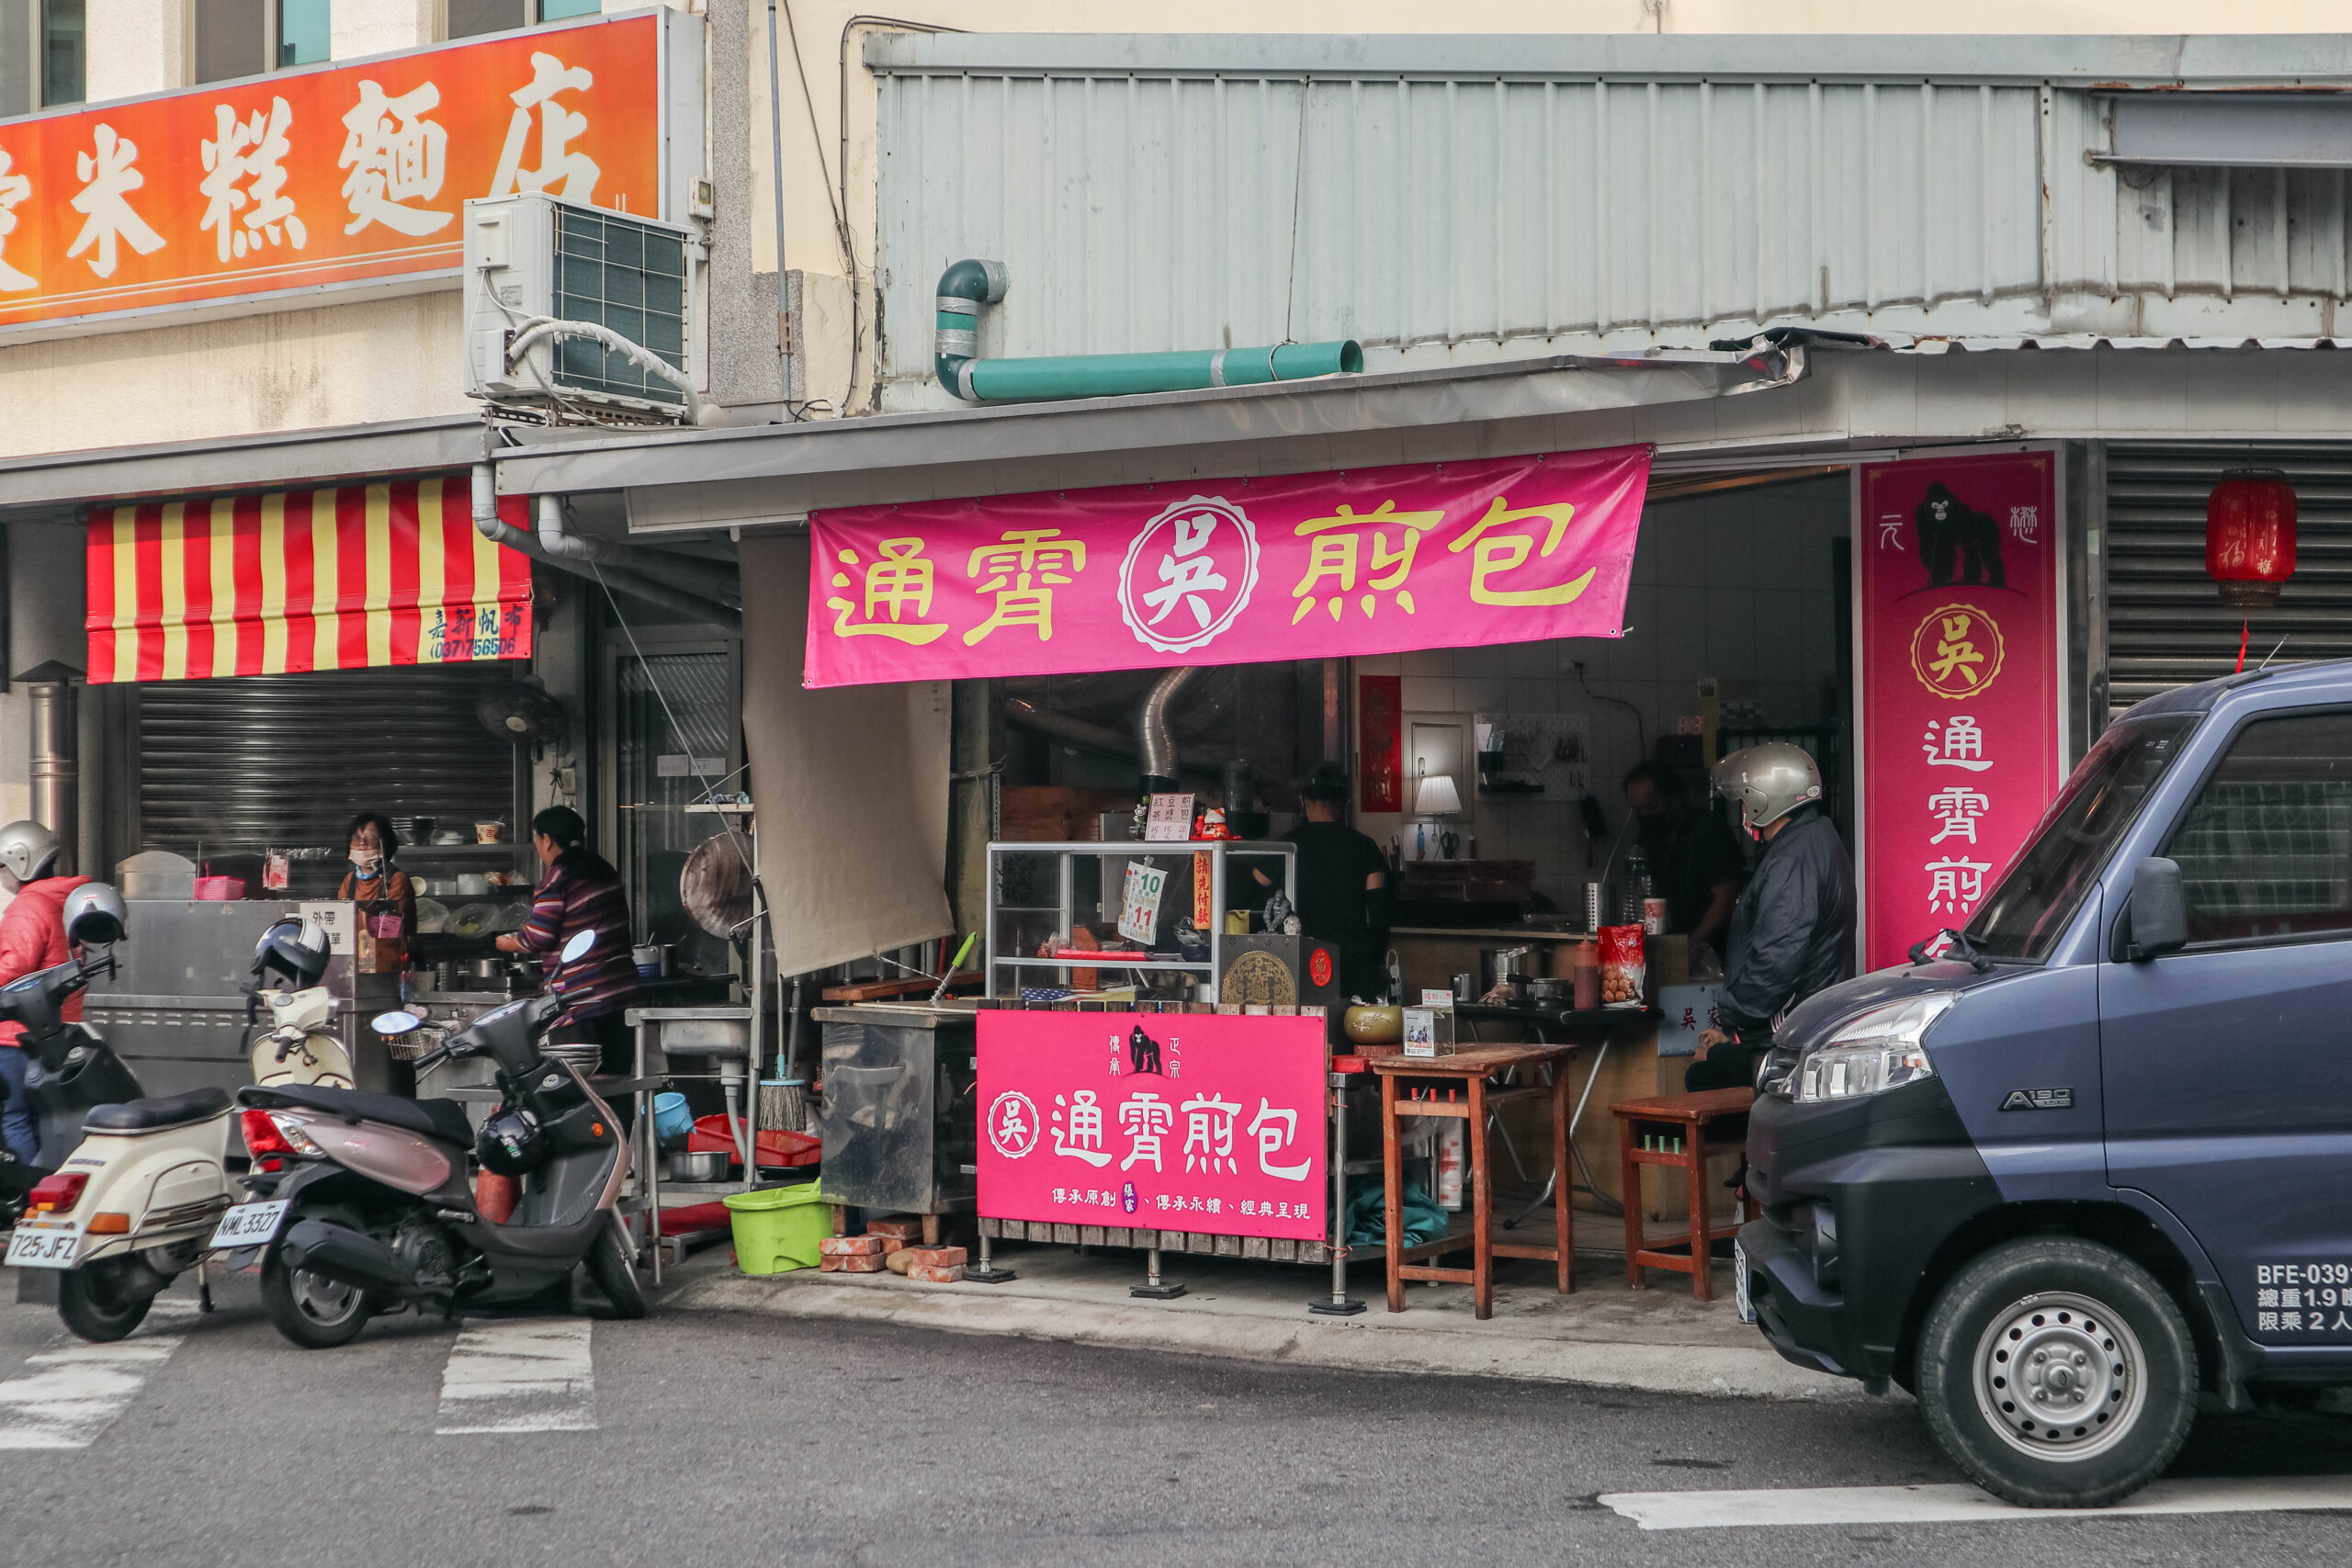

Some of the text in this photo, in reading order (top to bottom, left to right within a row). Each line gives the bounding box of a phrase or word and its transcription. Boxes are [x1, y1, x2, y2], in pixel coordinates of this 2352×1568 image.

[1880, 514, 1904, 550] 元
[827, 496, 1596, 647] 通霄 吳 煎包
[428, 604, 523, 639] 嘉新帆布
[430, 637, 515, 659] (037)756506
[1929, 614, 1984, 685] 吳
[1151, 826, 1159, 834] 15
[1922, 716, 1994, 957] 通霄煎
[1141, 874, 1160, 894] 10
[1197, 858, 1210, 924] 請先付款
[312, 910, 335, 926] 外帶
[1135, 906, 1152, 927] 11
[2004, 1089, 2071, 1110] A190
[998, 1089, 1312, 1181] 吳 通霄煎包
[1052, 1188, 1116, 1208] 傳承原創
[217, 1212, 279, 1236] NML-3327
[12, 1235, 77, 1259] 725-JFZ
